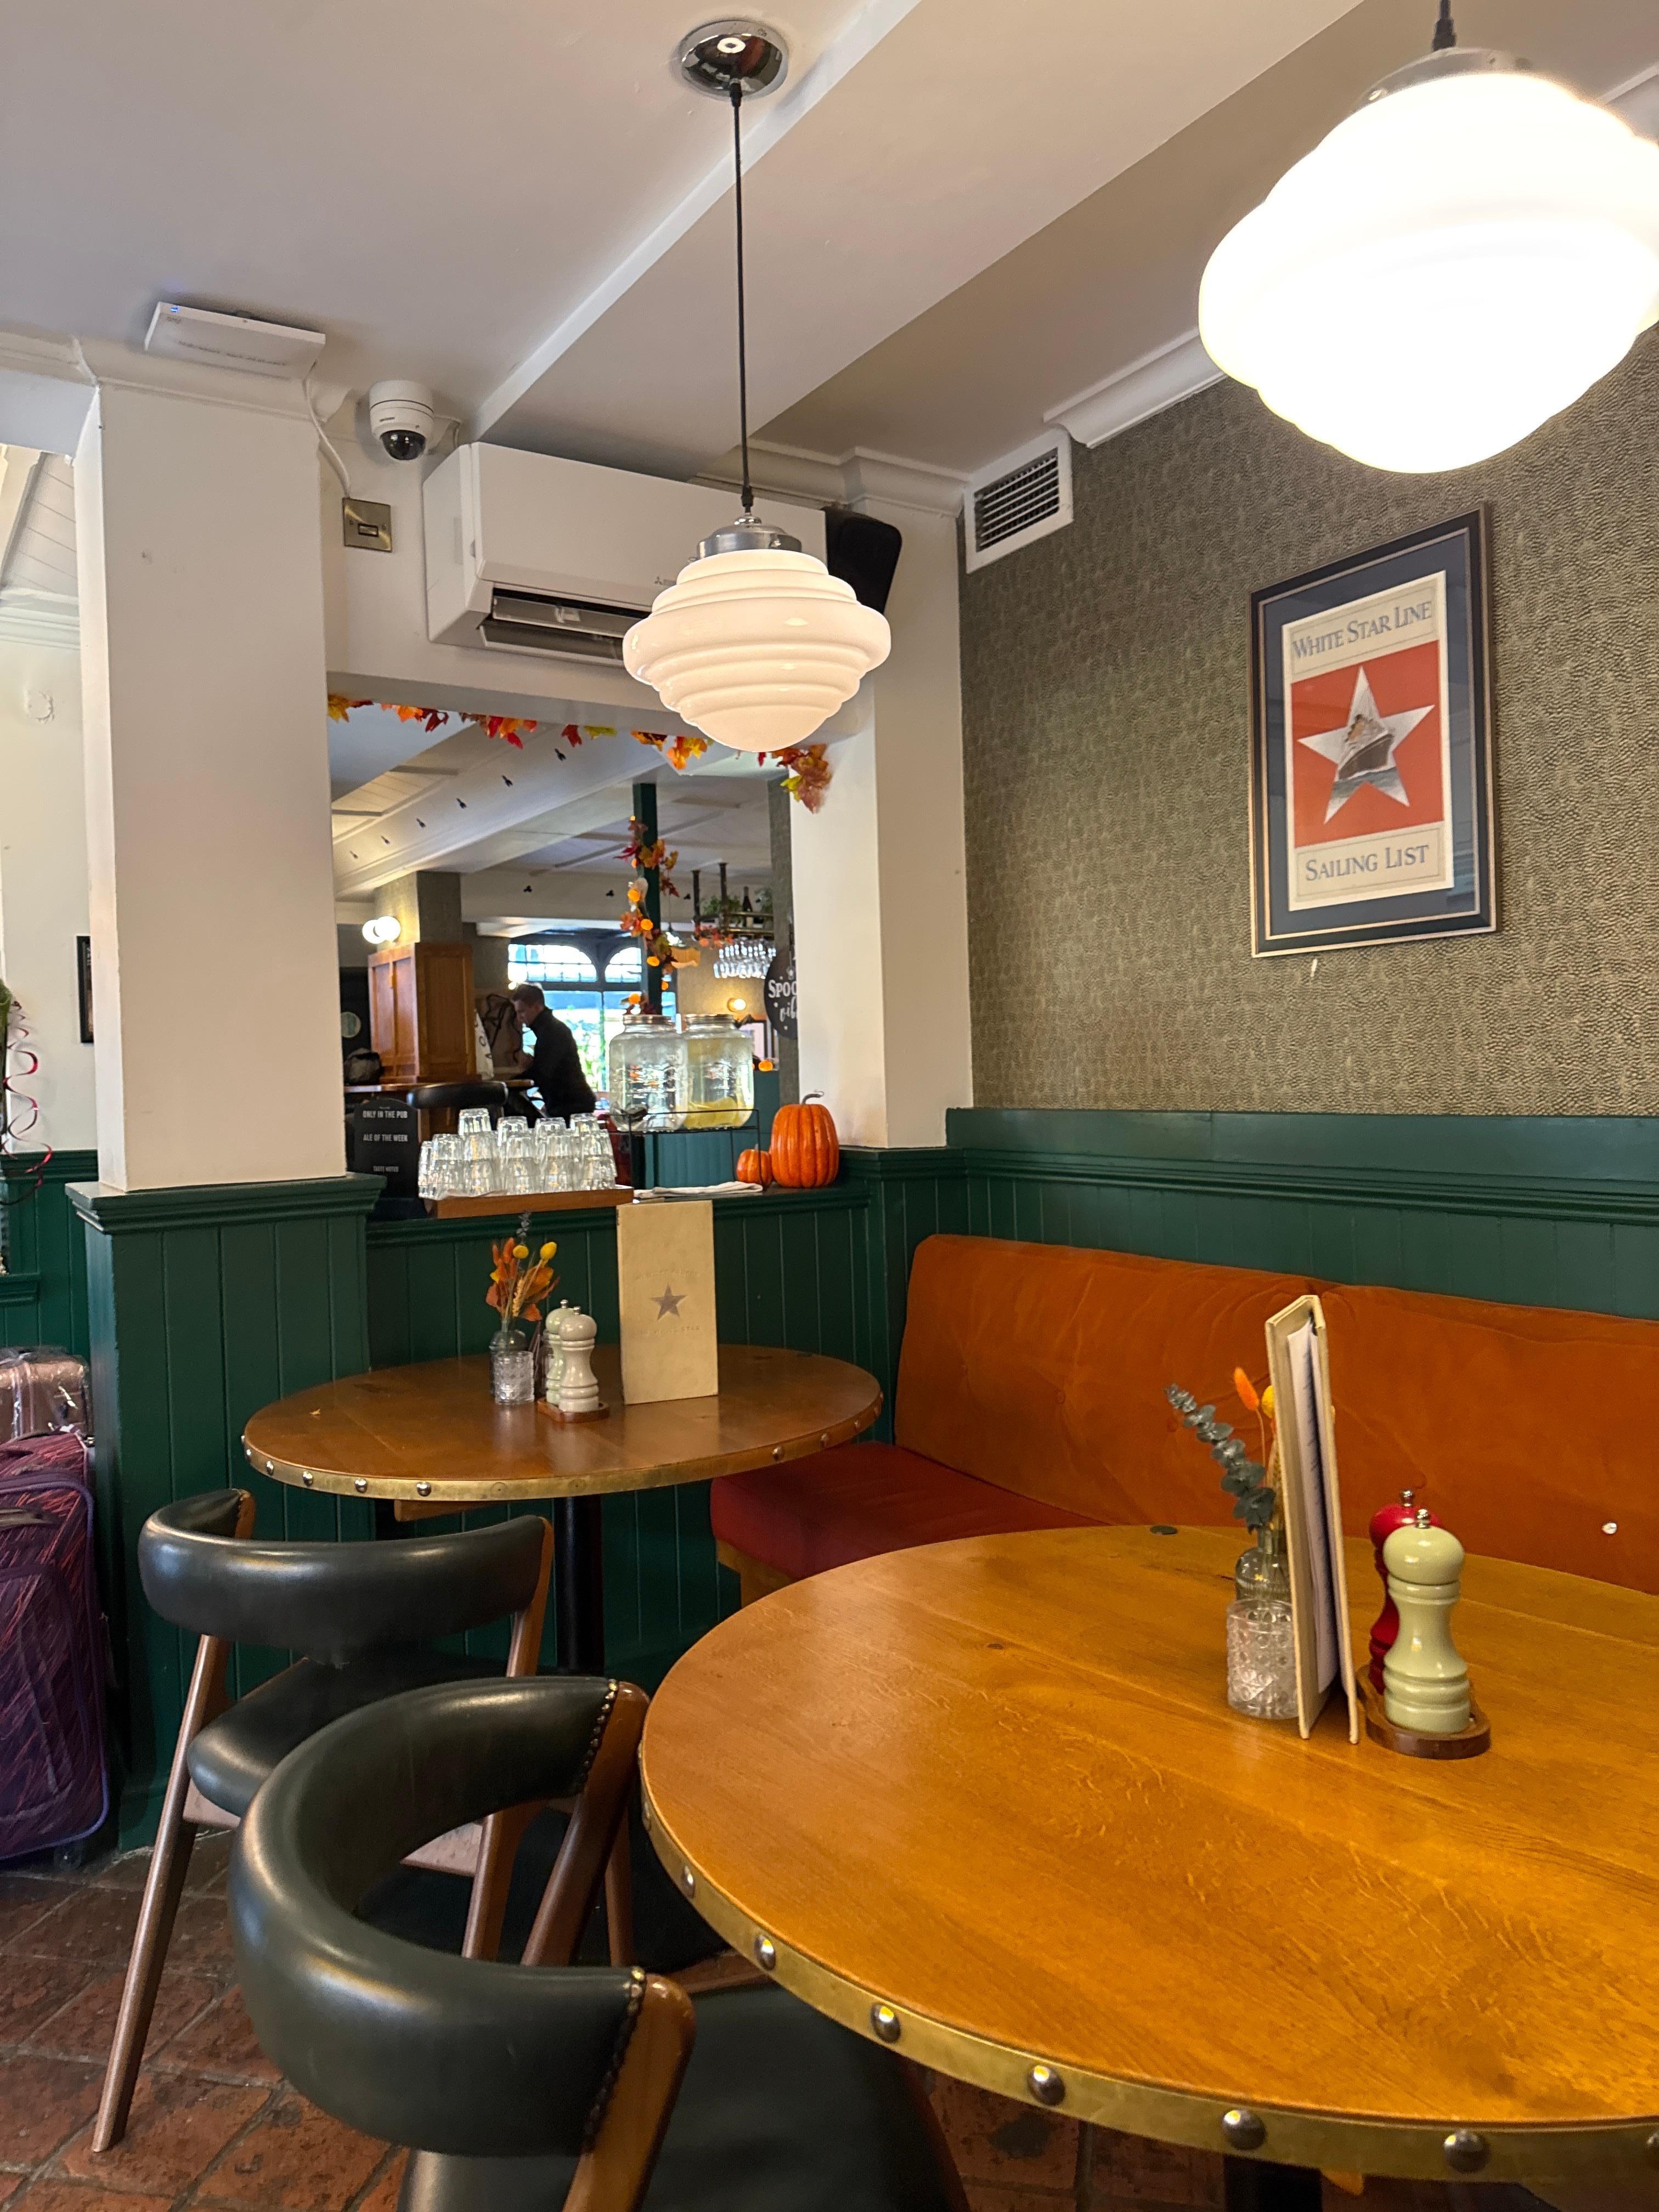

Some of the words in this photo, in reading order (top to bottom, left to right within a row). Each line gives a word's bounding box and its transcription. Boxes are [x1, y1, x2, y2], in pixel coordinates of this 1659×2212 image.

[1293, 630, 1344, 658] WHITE
[1347, 615, 1392, 644] STAR
[1393, 601, 1432, 629] LINE
[1305, 854, 1378, 881] SAILING
[1385, 845, 1429, 869] LIST
[768, 980, 797, 998] SPOO
